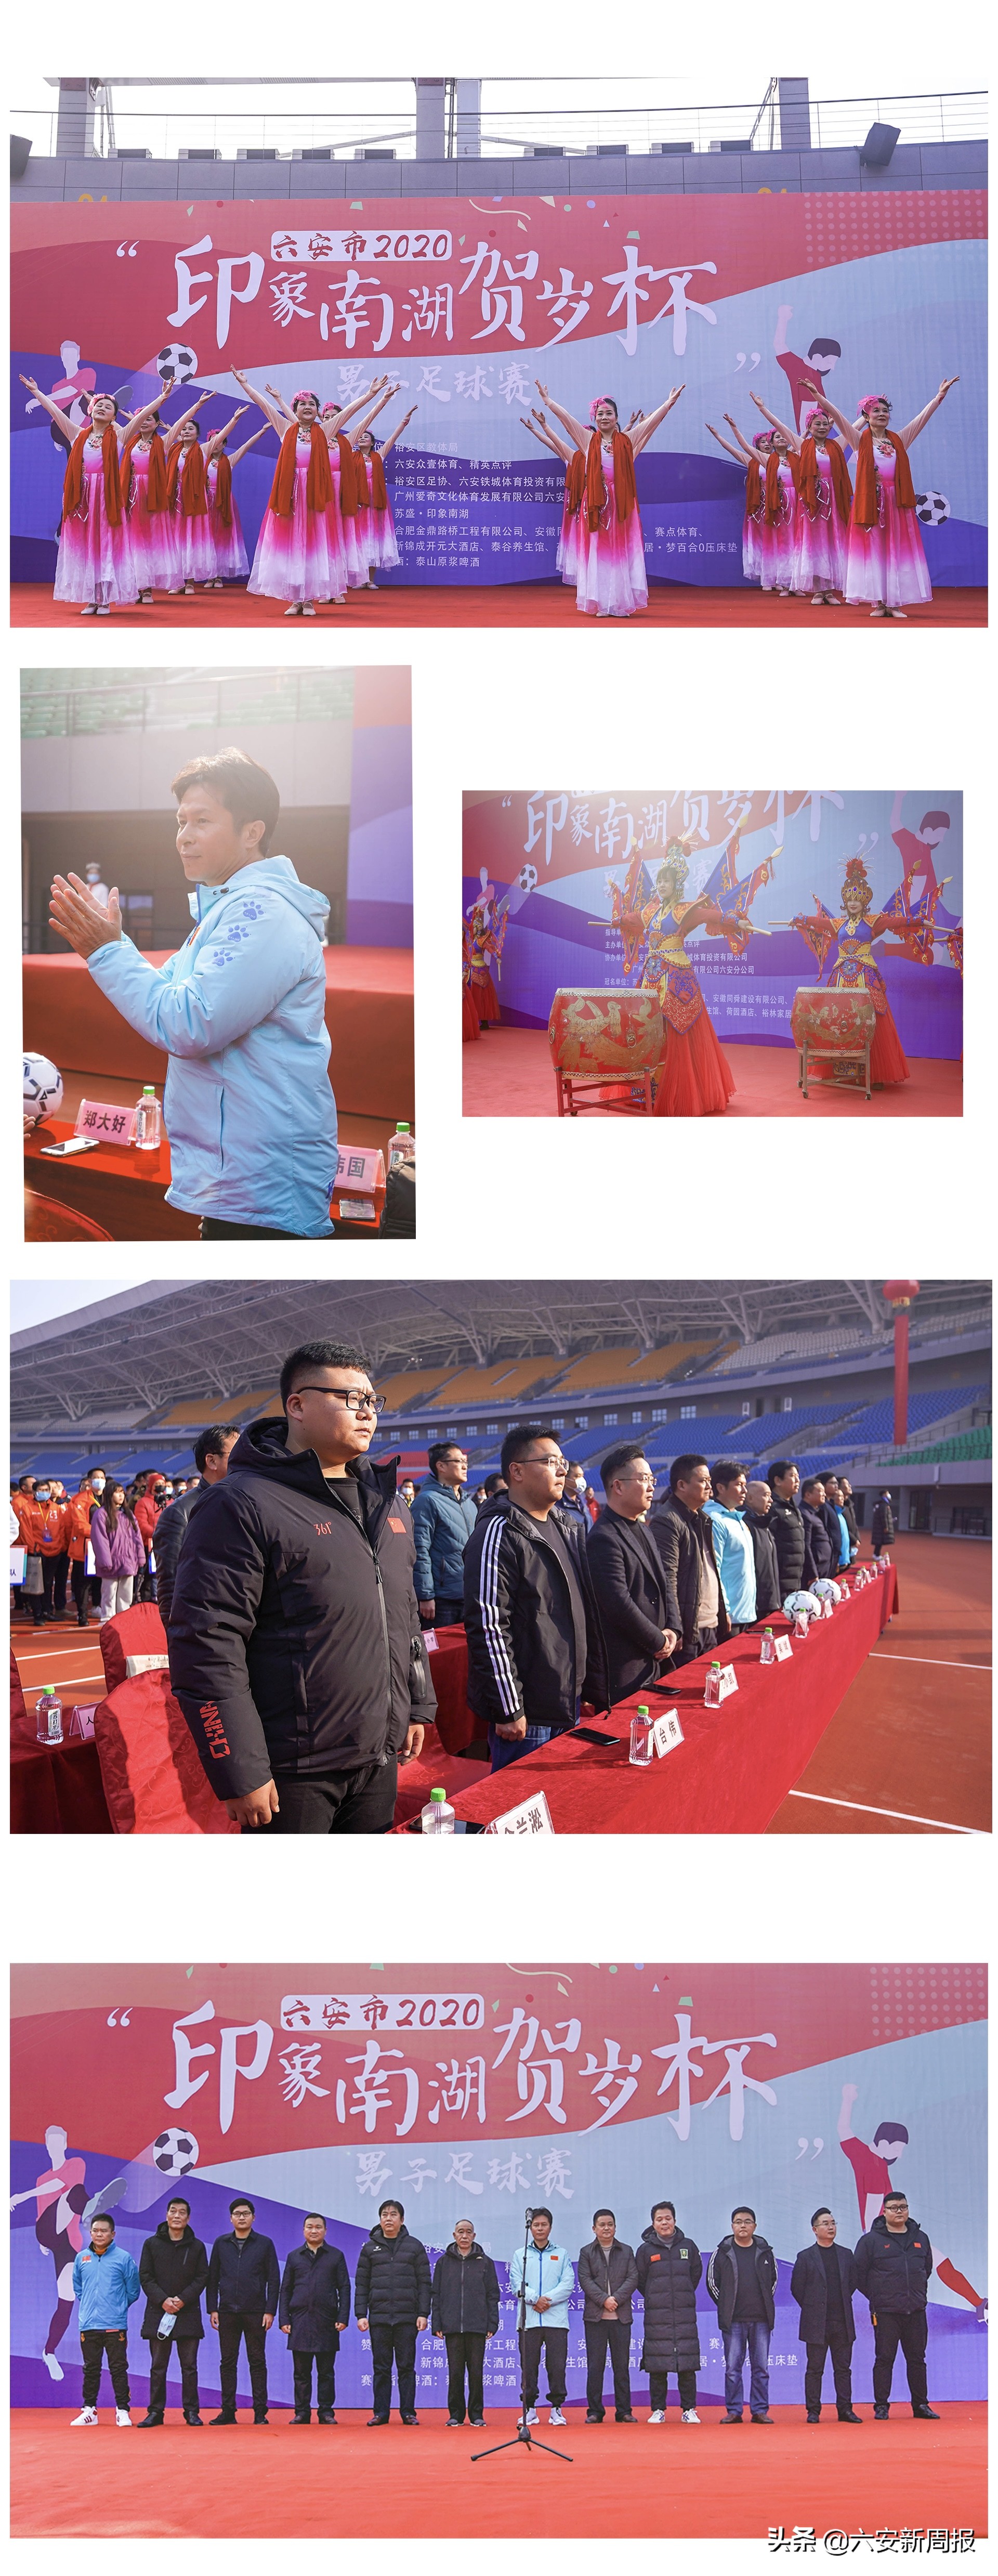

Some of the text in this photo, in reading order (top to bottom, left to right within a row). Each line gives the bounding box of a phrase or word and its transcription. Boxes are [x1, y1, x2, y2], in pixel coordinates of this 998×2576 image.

[272, 232, 448, 261] 六安市2020
[395, 442, 458, 452] 裕安区教体局
[83, 1110, 126, 1134] 郑大好
[282, 1996, 481, 2028] 六安市2020
[354, 2148, 574, 2199] 男子足球赛
